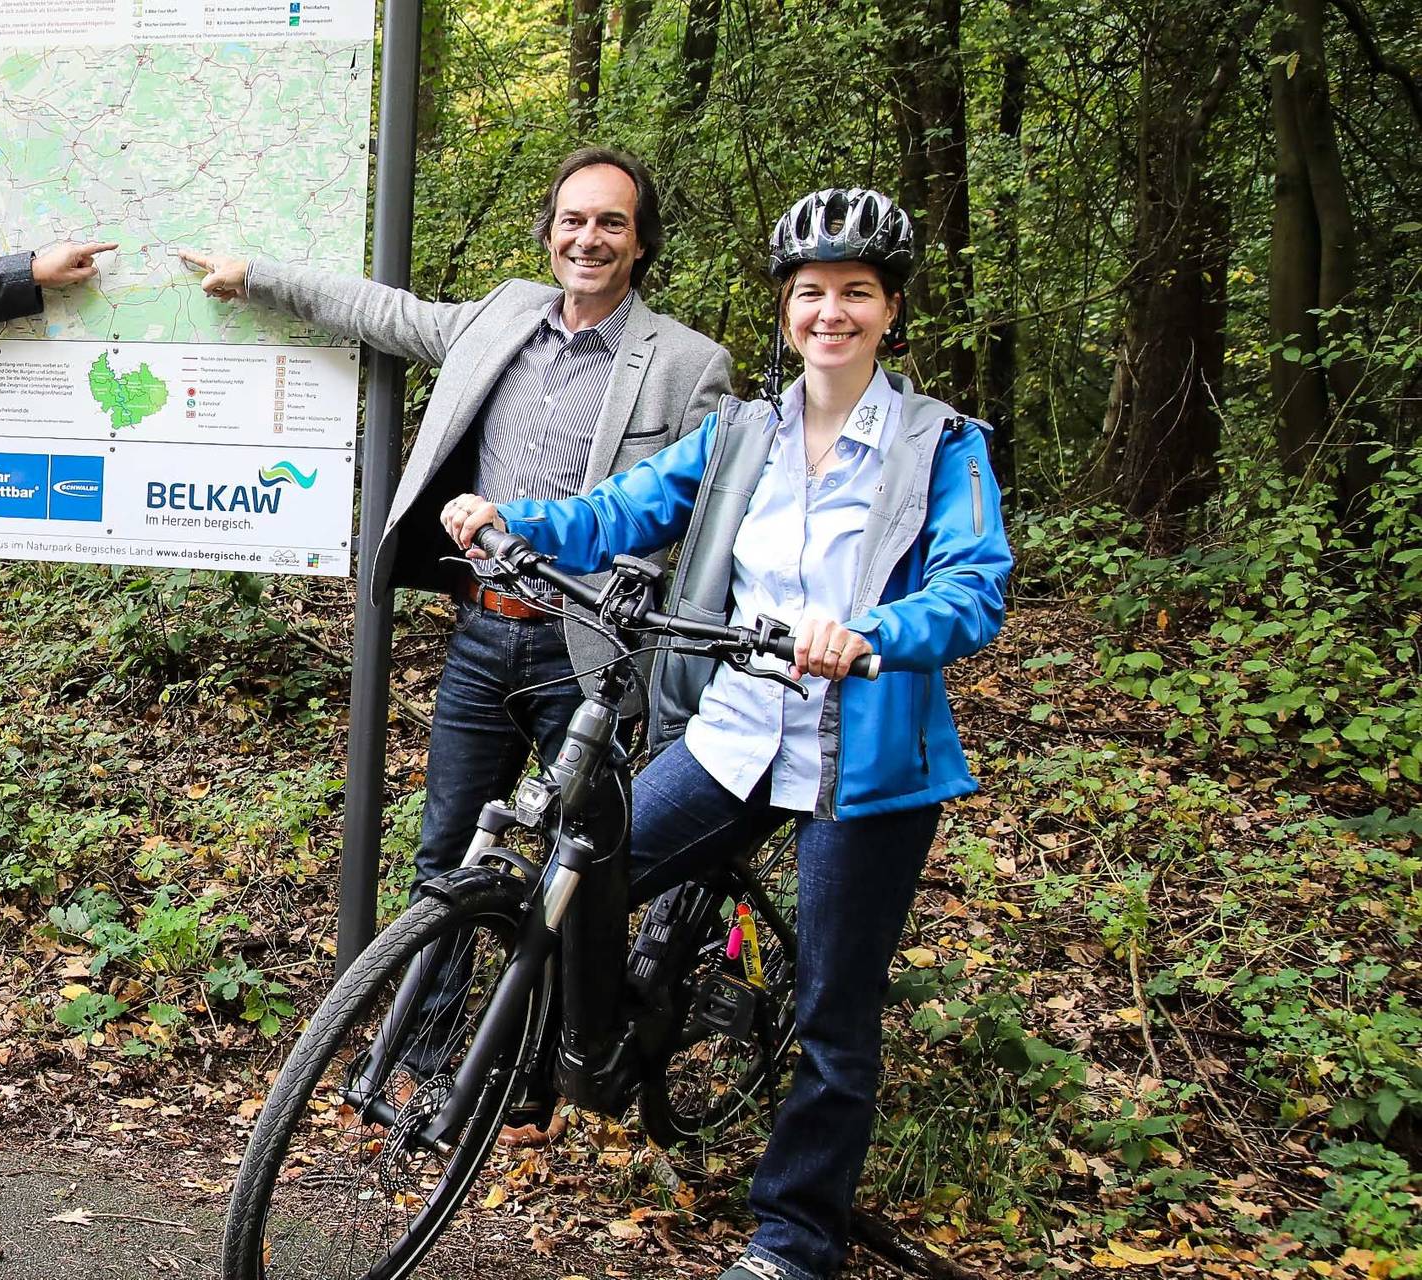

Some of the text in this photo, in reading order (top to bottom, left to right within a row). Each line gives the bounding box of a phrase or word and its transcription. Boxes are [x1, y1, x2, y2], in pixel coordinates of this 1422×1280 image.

[146, 482, 282, 514] BELKAW
[146, 514, 254, 531] Im Herzen bergisch.
[12, 541, 24, 550] im
[26, 541, 72, 553] Naturpark
[76, 543, 126, 556] Bergisches
[129, 547, 152, 556] Land
[156, 548, 261, 564] www.dasbergische.de
